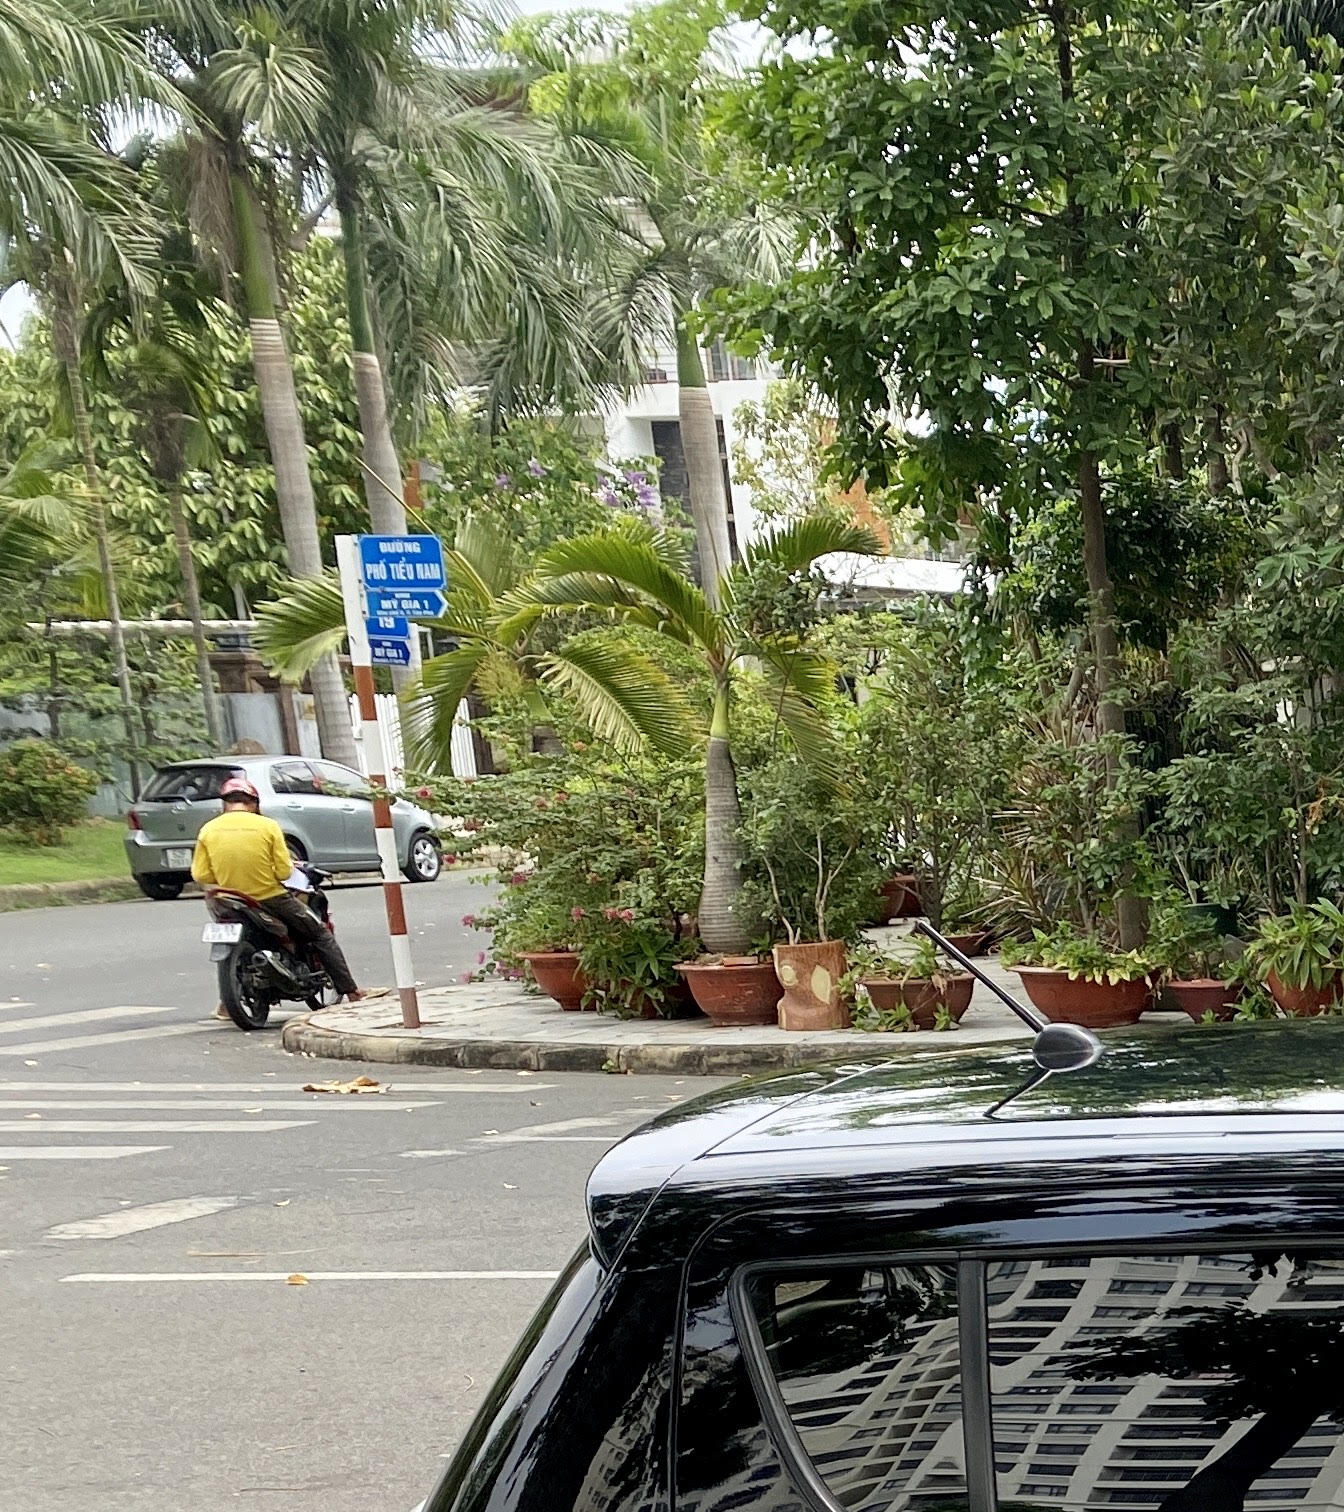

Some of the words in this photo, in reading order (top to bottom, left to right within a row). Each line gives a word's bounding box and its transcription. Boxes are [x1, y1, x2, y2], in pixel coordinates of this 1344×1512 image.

[379, 540, 421, 553] ĐƯỜNG
[365, 558, 387, 580] PHỐ
[389, 557, 414, 580] TIỂU
[416, 563, 441, 579] NAM
